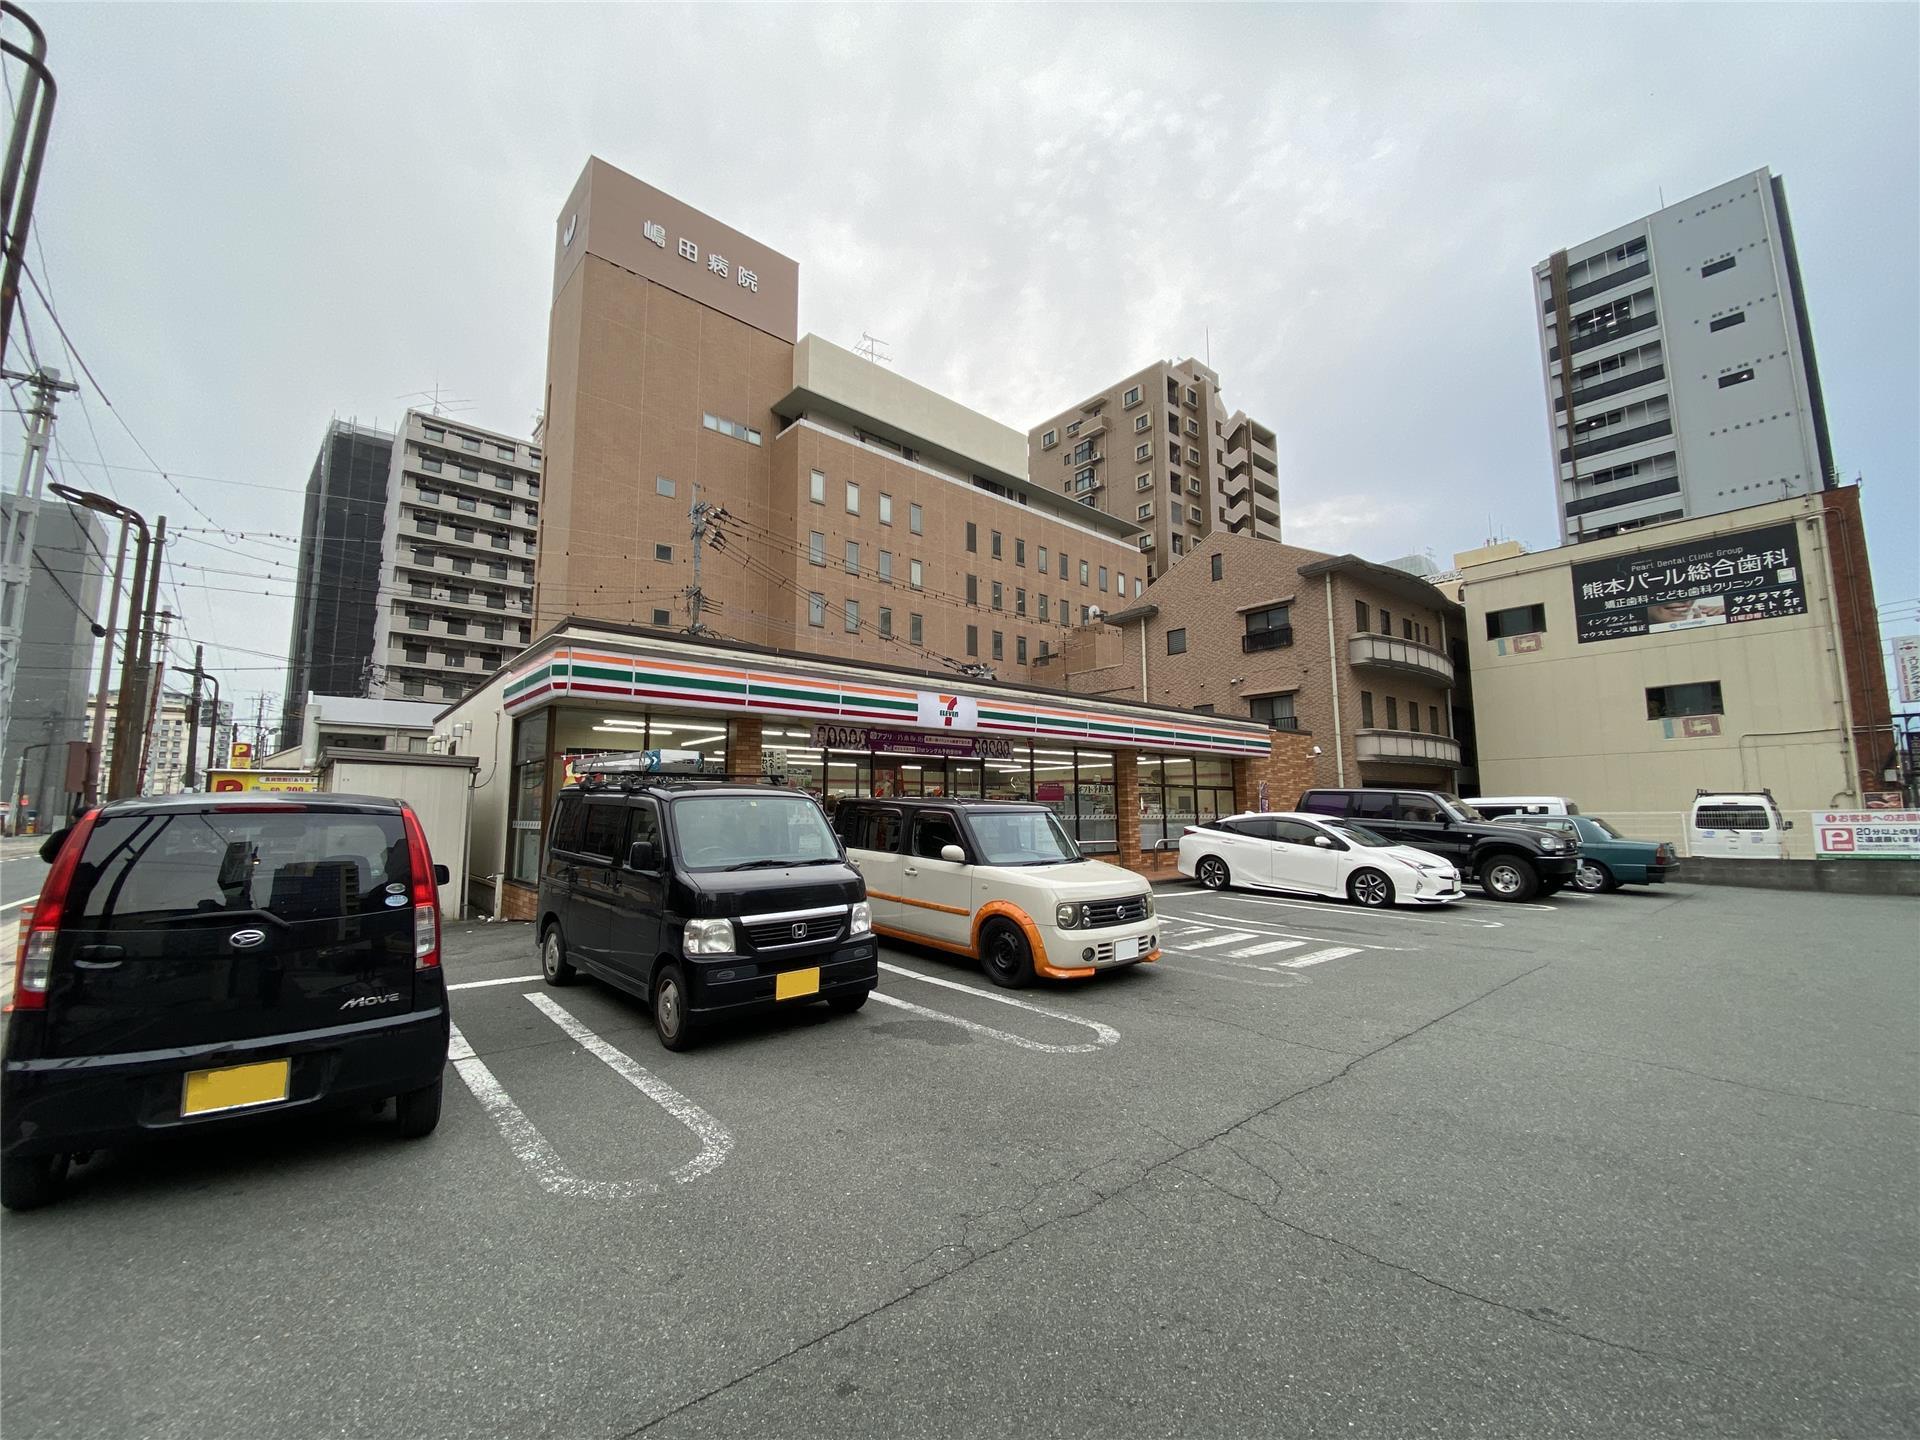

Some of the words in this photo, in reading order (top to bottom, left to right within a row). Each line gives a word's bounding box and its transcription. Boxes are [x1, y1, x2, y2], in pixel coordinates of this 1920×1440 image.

[643, 219, 758, 293] 嶋田病院
[1631, 564, 1654, 572] Pearl
[1657, 557, 1686, 568] Dental
[1688, 551, 1714, 561] Clinic
[1716, 546, 1744, 557] Group
[1582, 548, 1789, 600] 熊本パール総合歯科
[1733, 588, 1794, 604] サクラマチ
[1730, 601, 1777, 614] クマモト
[1783, 598, 1801, 607] 2F
[1587, 613, 1635, 626] インプラント
[234, 744, 248, 756] P
[340, 992, 400, 1010] MOVE
